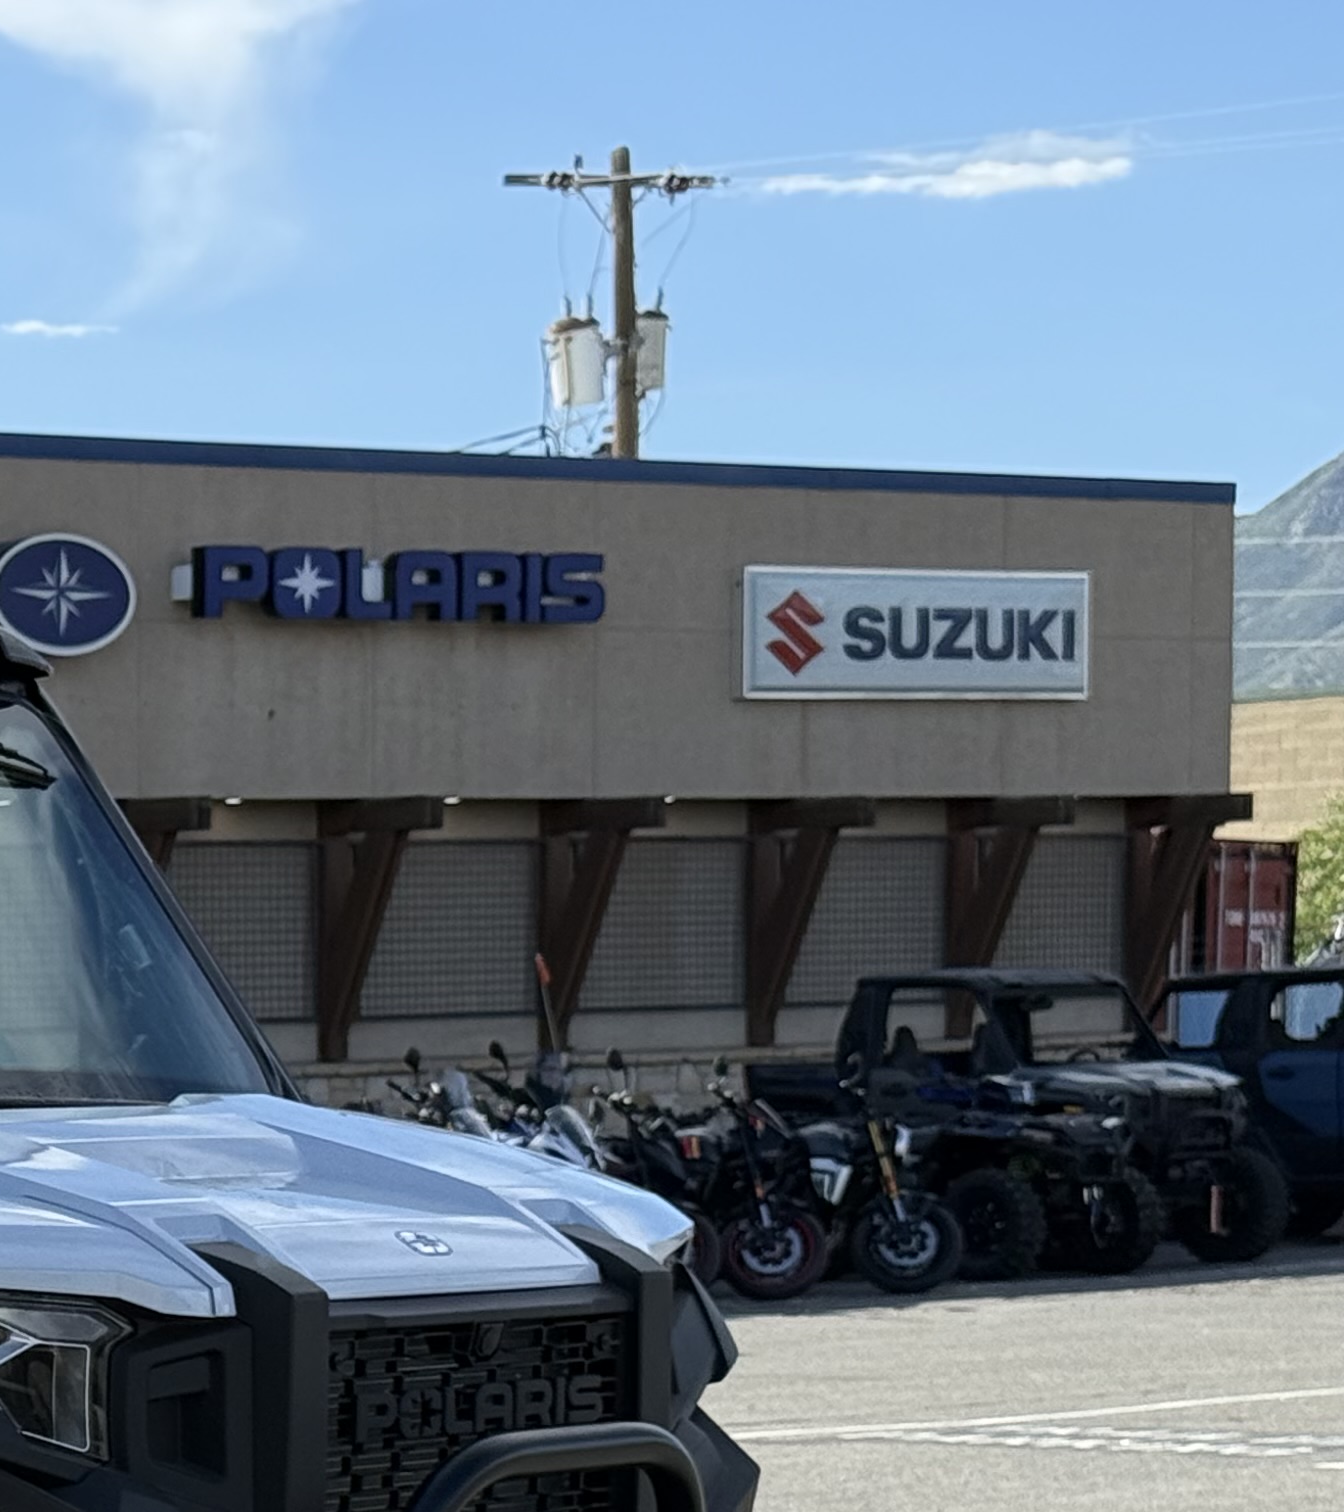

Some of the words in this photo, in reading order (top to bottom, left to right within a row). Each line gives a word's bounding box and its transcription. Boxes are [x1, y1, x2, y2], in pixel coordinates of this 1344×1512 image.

[191, 545, 605, 624] POLARIS
[842, 606, 1076, 662] SUZUKI
[355, 1374, 605, 1444] POLARIS
